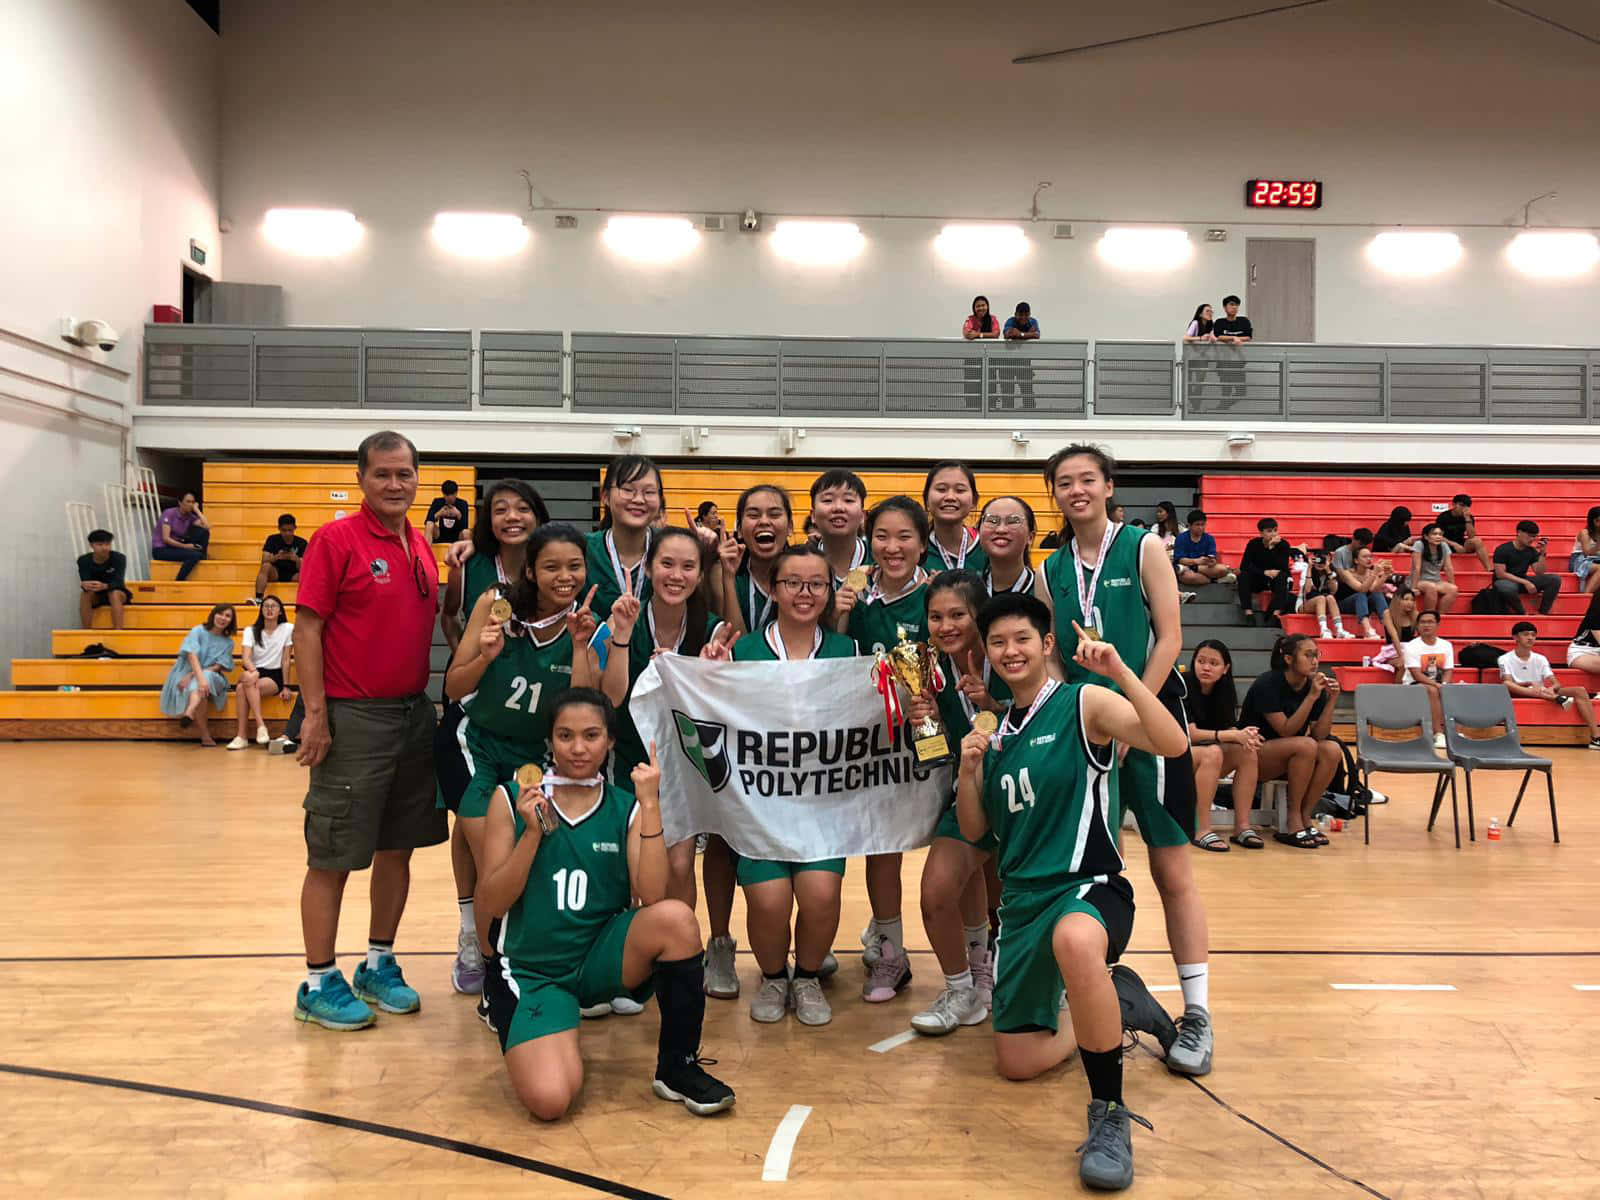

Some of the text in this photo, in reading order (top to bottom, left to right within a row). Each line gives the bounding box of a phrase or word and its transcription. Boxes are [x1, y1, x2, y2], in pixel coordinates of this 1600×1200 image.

[1254, 182, 1316, 205] 22:59
[505, 676, 542, 714] 21
[1001, 767, 1035, 813] 24
[553, 868, 587, 911] 10
